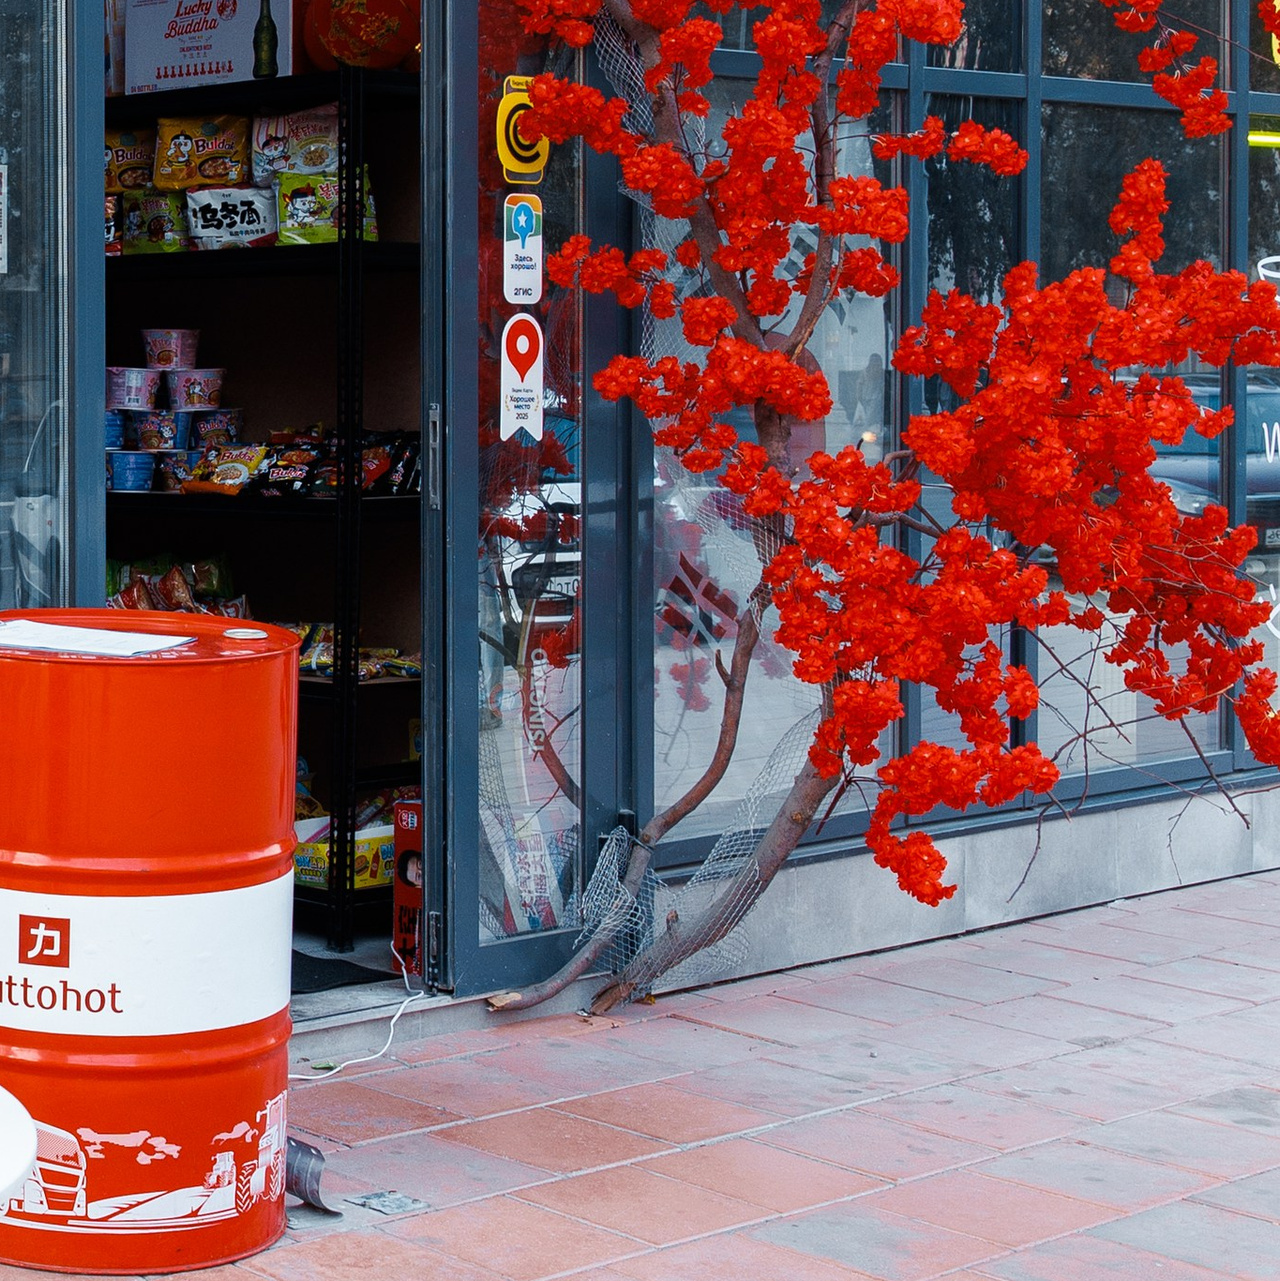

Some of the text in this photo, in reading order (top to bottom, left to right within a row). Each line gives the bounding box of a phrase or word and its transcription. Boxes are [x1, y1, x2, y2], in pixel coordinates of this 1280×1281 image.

[164, 18, 219, 39] Buddha
[514, 254, 533, 262] Здесь
[510, 263, 537, 271] хорошо!
[513, 287, 533, 296] 2ГИС
[509, 395, 536, 403] Хорошее
